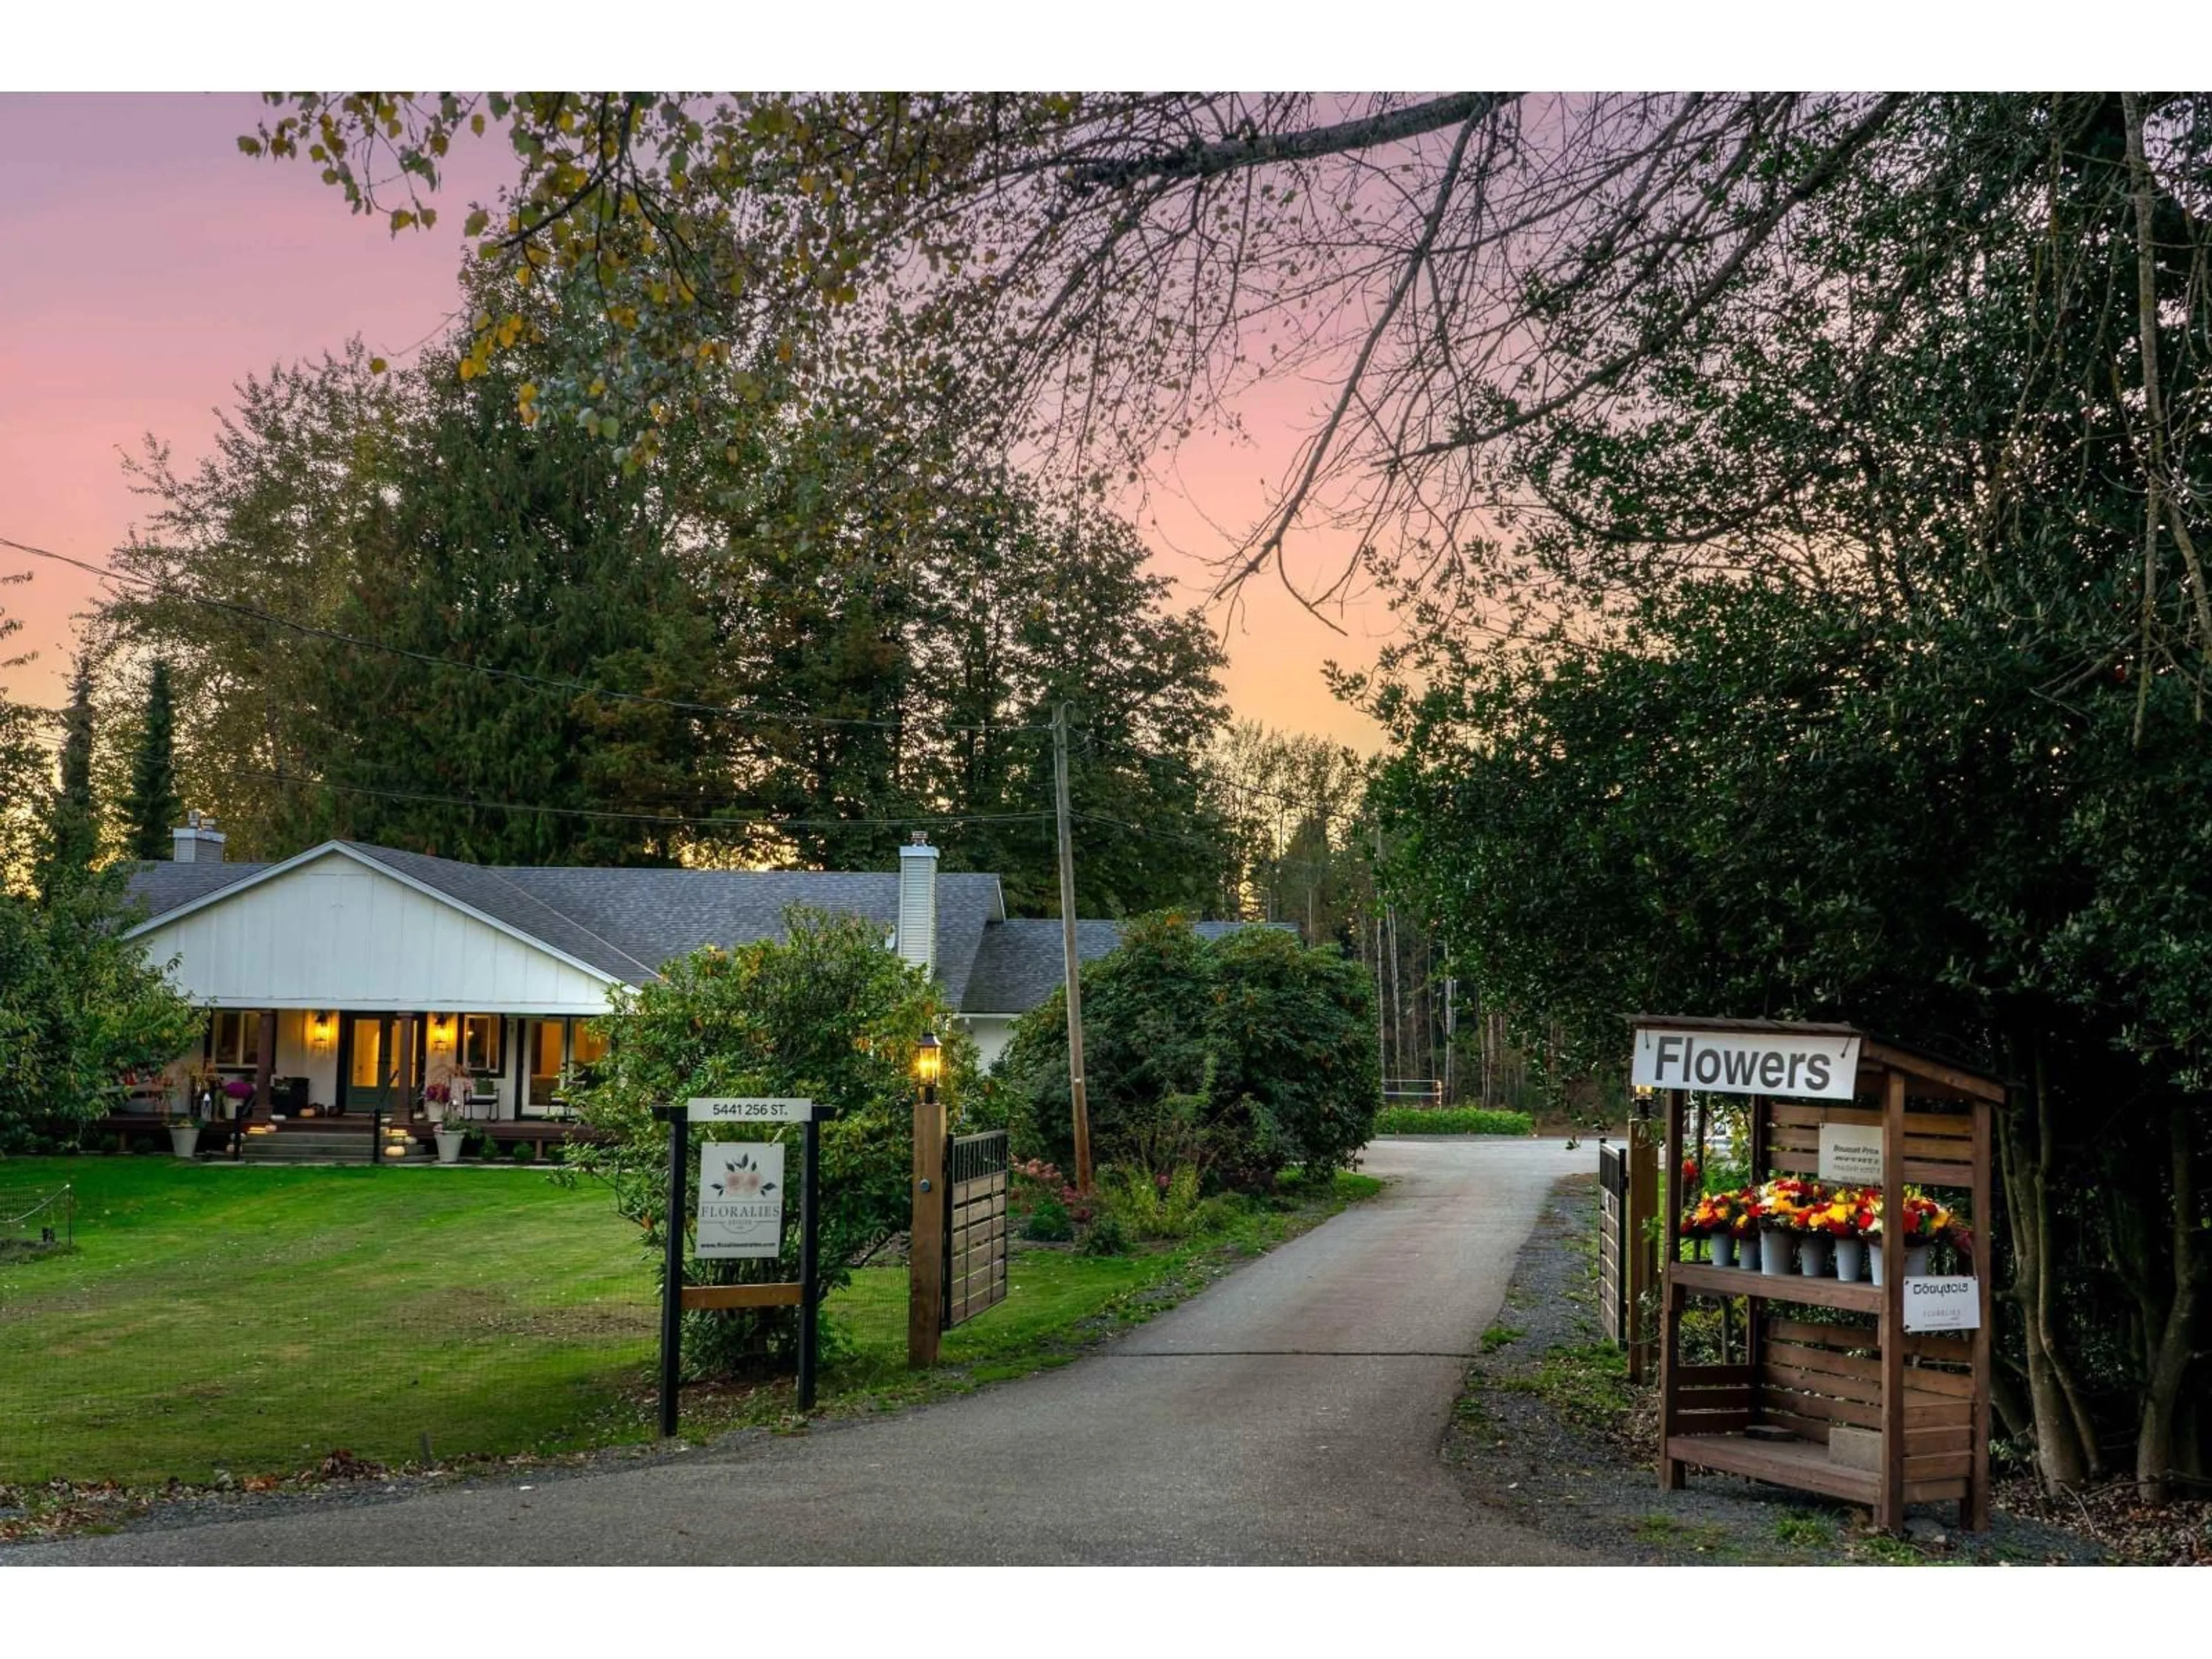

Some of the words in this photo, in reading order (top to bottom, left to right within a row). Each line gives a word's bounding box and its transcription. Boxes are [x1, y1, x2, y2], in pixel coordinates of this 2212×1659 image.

[1654, 1036, 1831, 1091] Flowers
[713, 1104, 743, 1115] 5441
[745, 1104, 768, 1115] 256
[771, 1104, 788, 1115] ST.
[700, 1205, 780, 1218] FLORALIES
